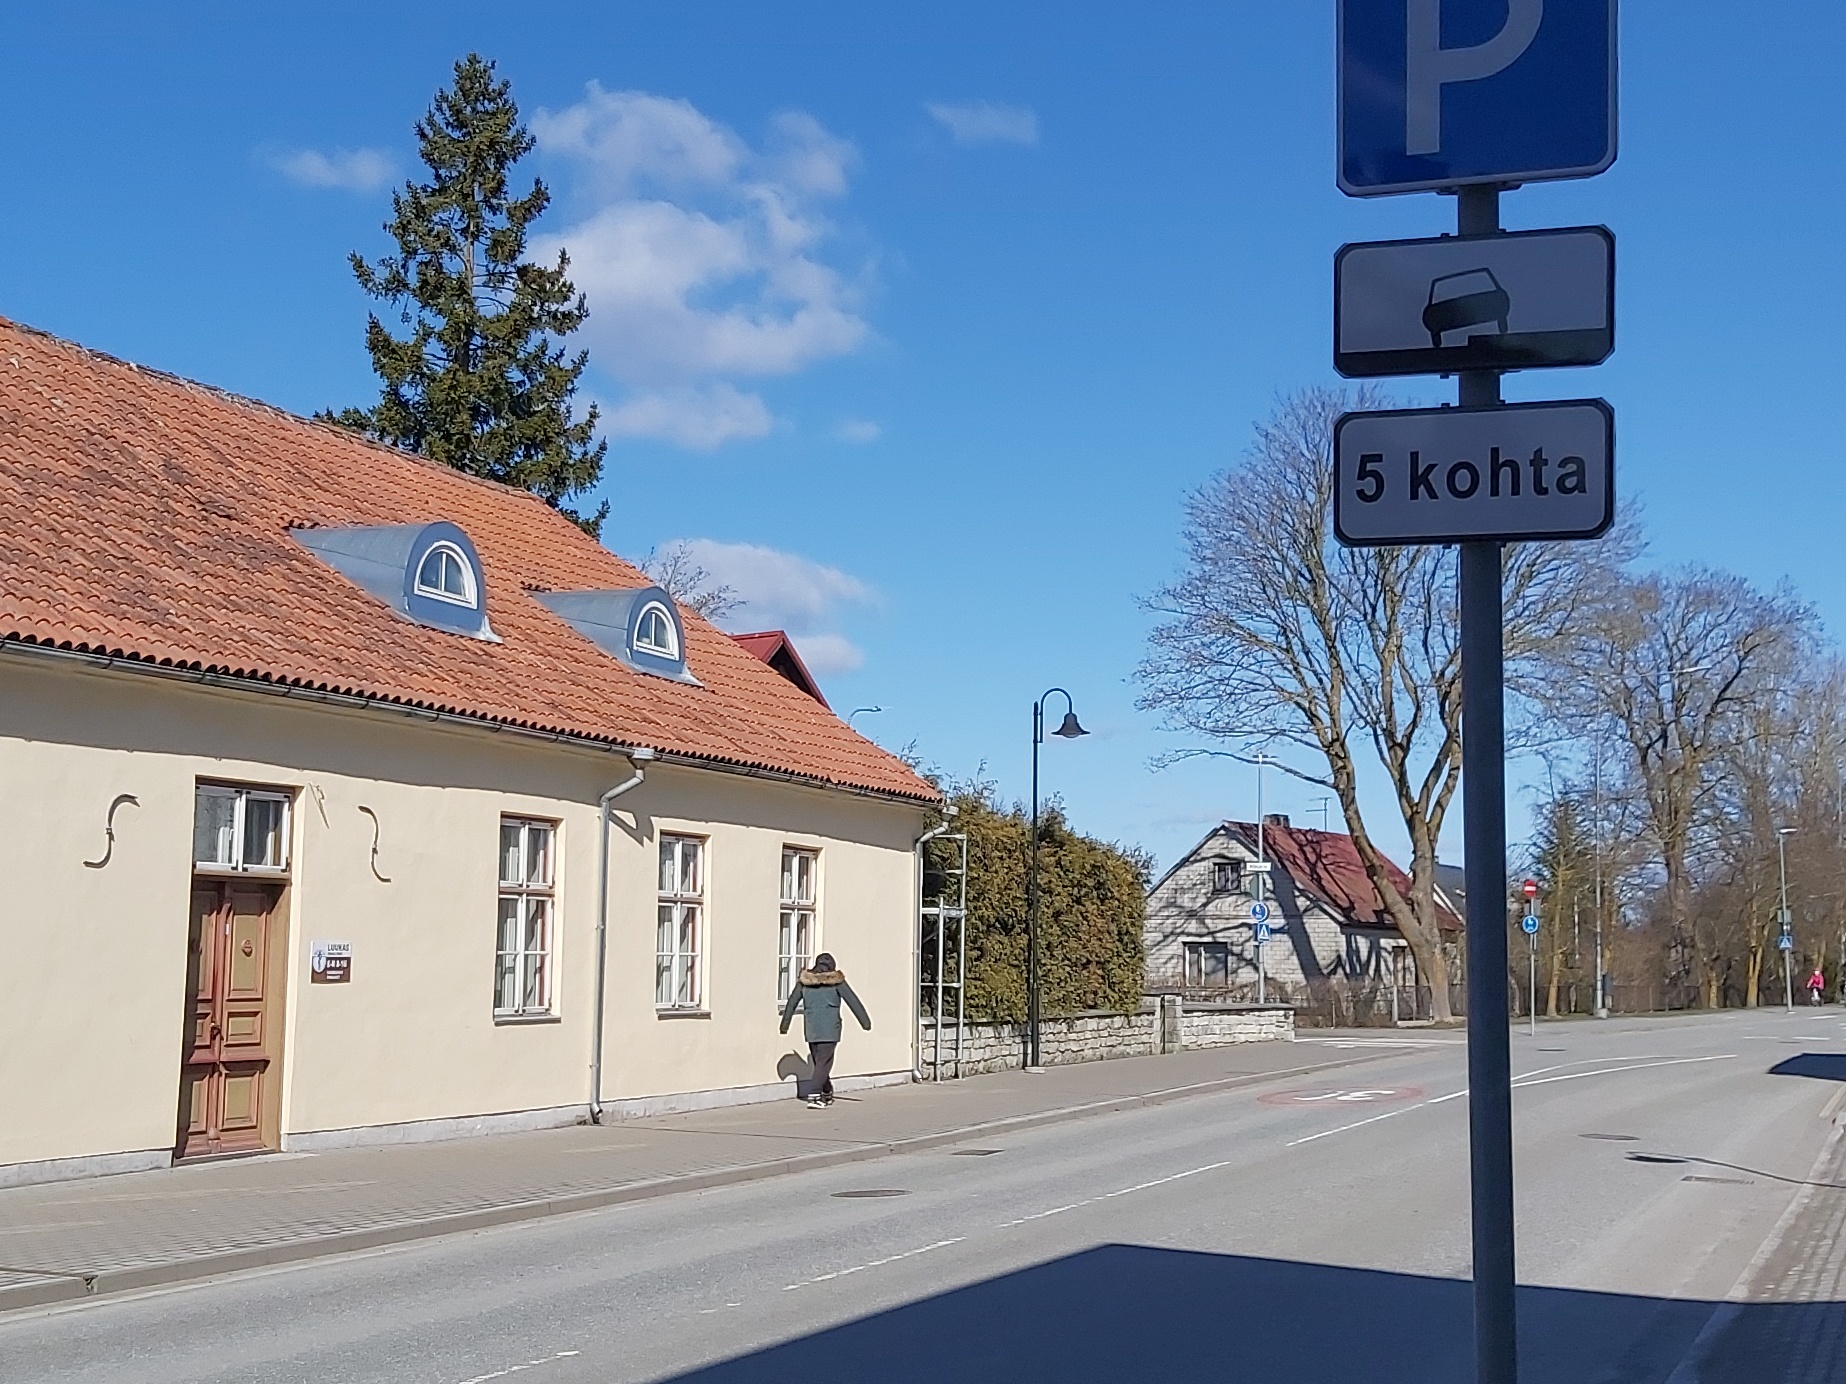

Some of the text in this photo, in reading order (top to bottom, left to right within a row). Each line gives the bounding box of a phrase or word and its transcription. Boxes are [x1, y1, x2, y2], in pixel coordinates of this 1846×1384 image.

[1406, 0, 1544, 155] P
[1355, 446, 1588, 503] 5 kohta
